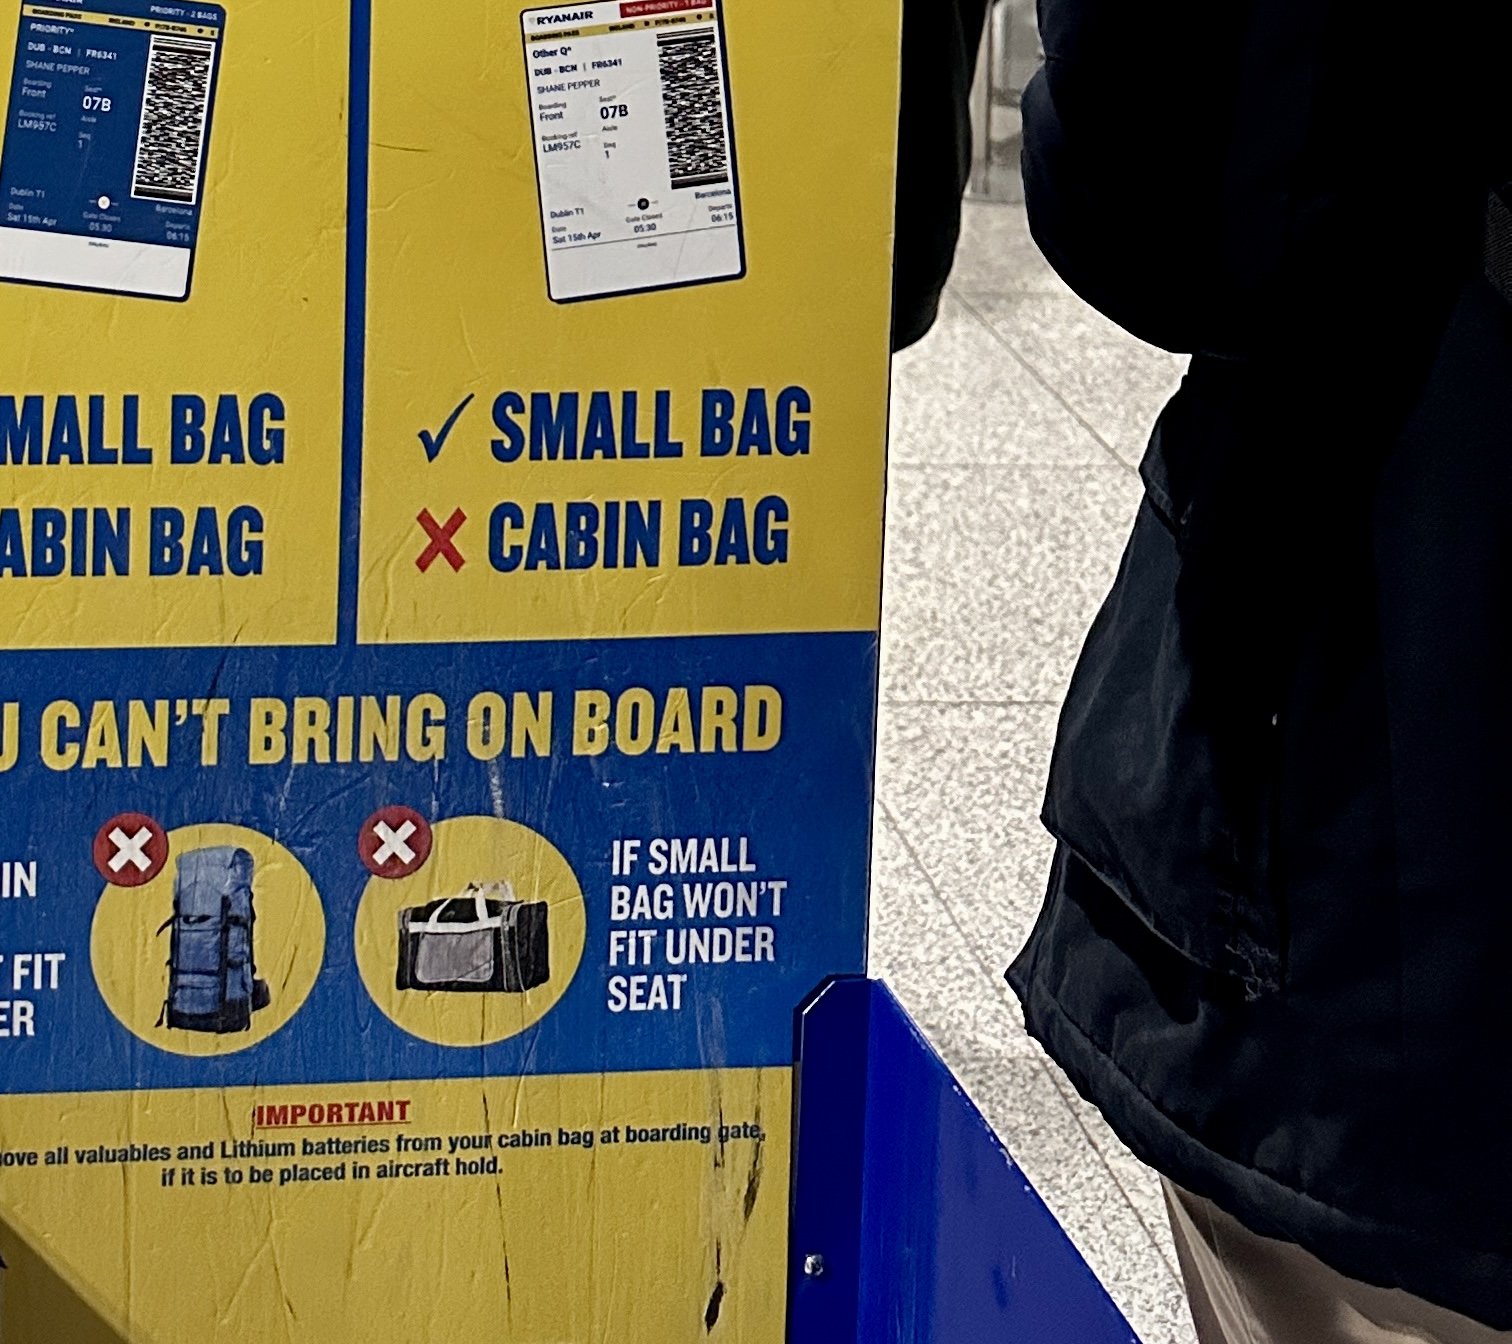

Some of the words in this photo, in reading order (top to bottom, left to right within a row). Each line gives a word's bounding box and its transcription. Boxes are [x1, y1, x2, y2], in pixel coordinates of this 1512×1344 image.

[537, 10, 594, 25] RYANAIR
[56, 62, 90, 75] PEPPER
[532, 48, 558, 59] Other
[82, 96, 112, 112] 07B
[537, 83, 566, 94] SHANE
[567, 79, 600, 90] PEPPER
[600, 104, 629, 119] 07B
[171, 393, 284, 465] BAG
[491, 390, 683, 462] SMALL
[700, 386, 810, 457] BAG
[149, 505, 263, 576] BAG
[489, 500, 661, 572] CABIN
[679, 496, 788, 566] BAG
[41, 699, 229, 770] CAN'T
[249, 693, 445, 767] BRING
[467, 692, 552, 763] ON
[573, 686, 781, 756] BOARD
[613, 840, 640, 875] IF
[648, 837, 755, 875] SMALL
[611, 884, 673, 920] BAG
[683, 881, 787, 918] WON'T
[610, 930, 657, 966] FIT
[666, 927, 774, 964] UNDER
[14, 953, 65, 990] FIT
[608, 974, 687, 1012] SEAT
[255, 1100, 411, 1124] IMPORTANT
[44, 1147, 68, 1165] all
[75, 1143, 171, 1163] valuables
[176, 1141, 214, 1160] and
[220, 1138, 296, 1159] Lithium
[302, 1134, 390, 1157] batteries
[396, 1134, 442, 1152] from
[448, 1135, 492, 1153] your
[498, 1128, 552, 1149] cabin
[558, 1127, 594, 1149] bag
[600, 1127, 620, 1144] at
[625, 1123, 711, 1145] boarding
[161, 1168, 177, 1186] if
[181, 1167, 195, 1185] it
[201, 1166, 218, 1184] is
[223, 1166, 243, 1183] to
[249, 1165, 273, 1183] be
[279, 1163, 345, 1185] placed
[352, 1161, 370, 1179] in
[376, 1157, 449, 1178] aircraft
[455, 1156, 504, 1175] hold.
